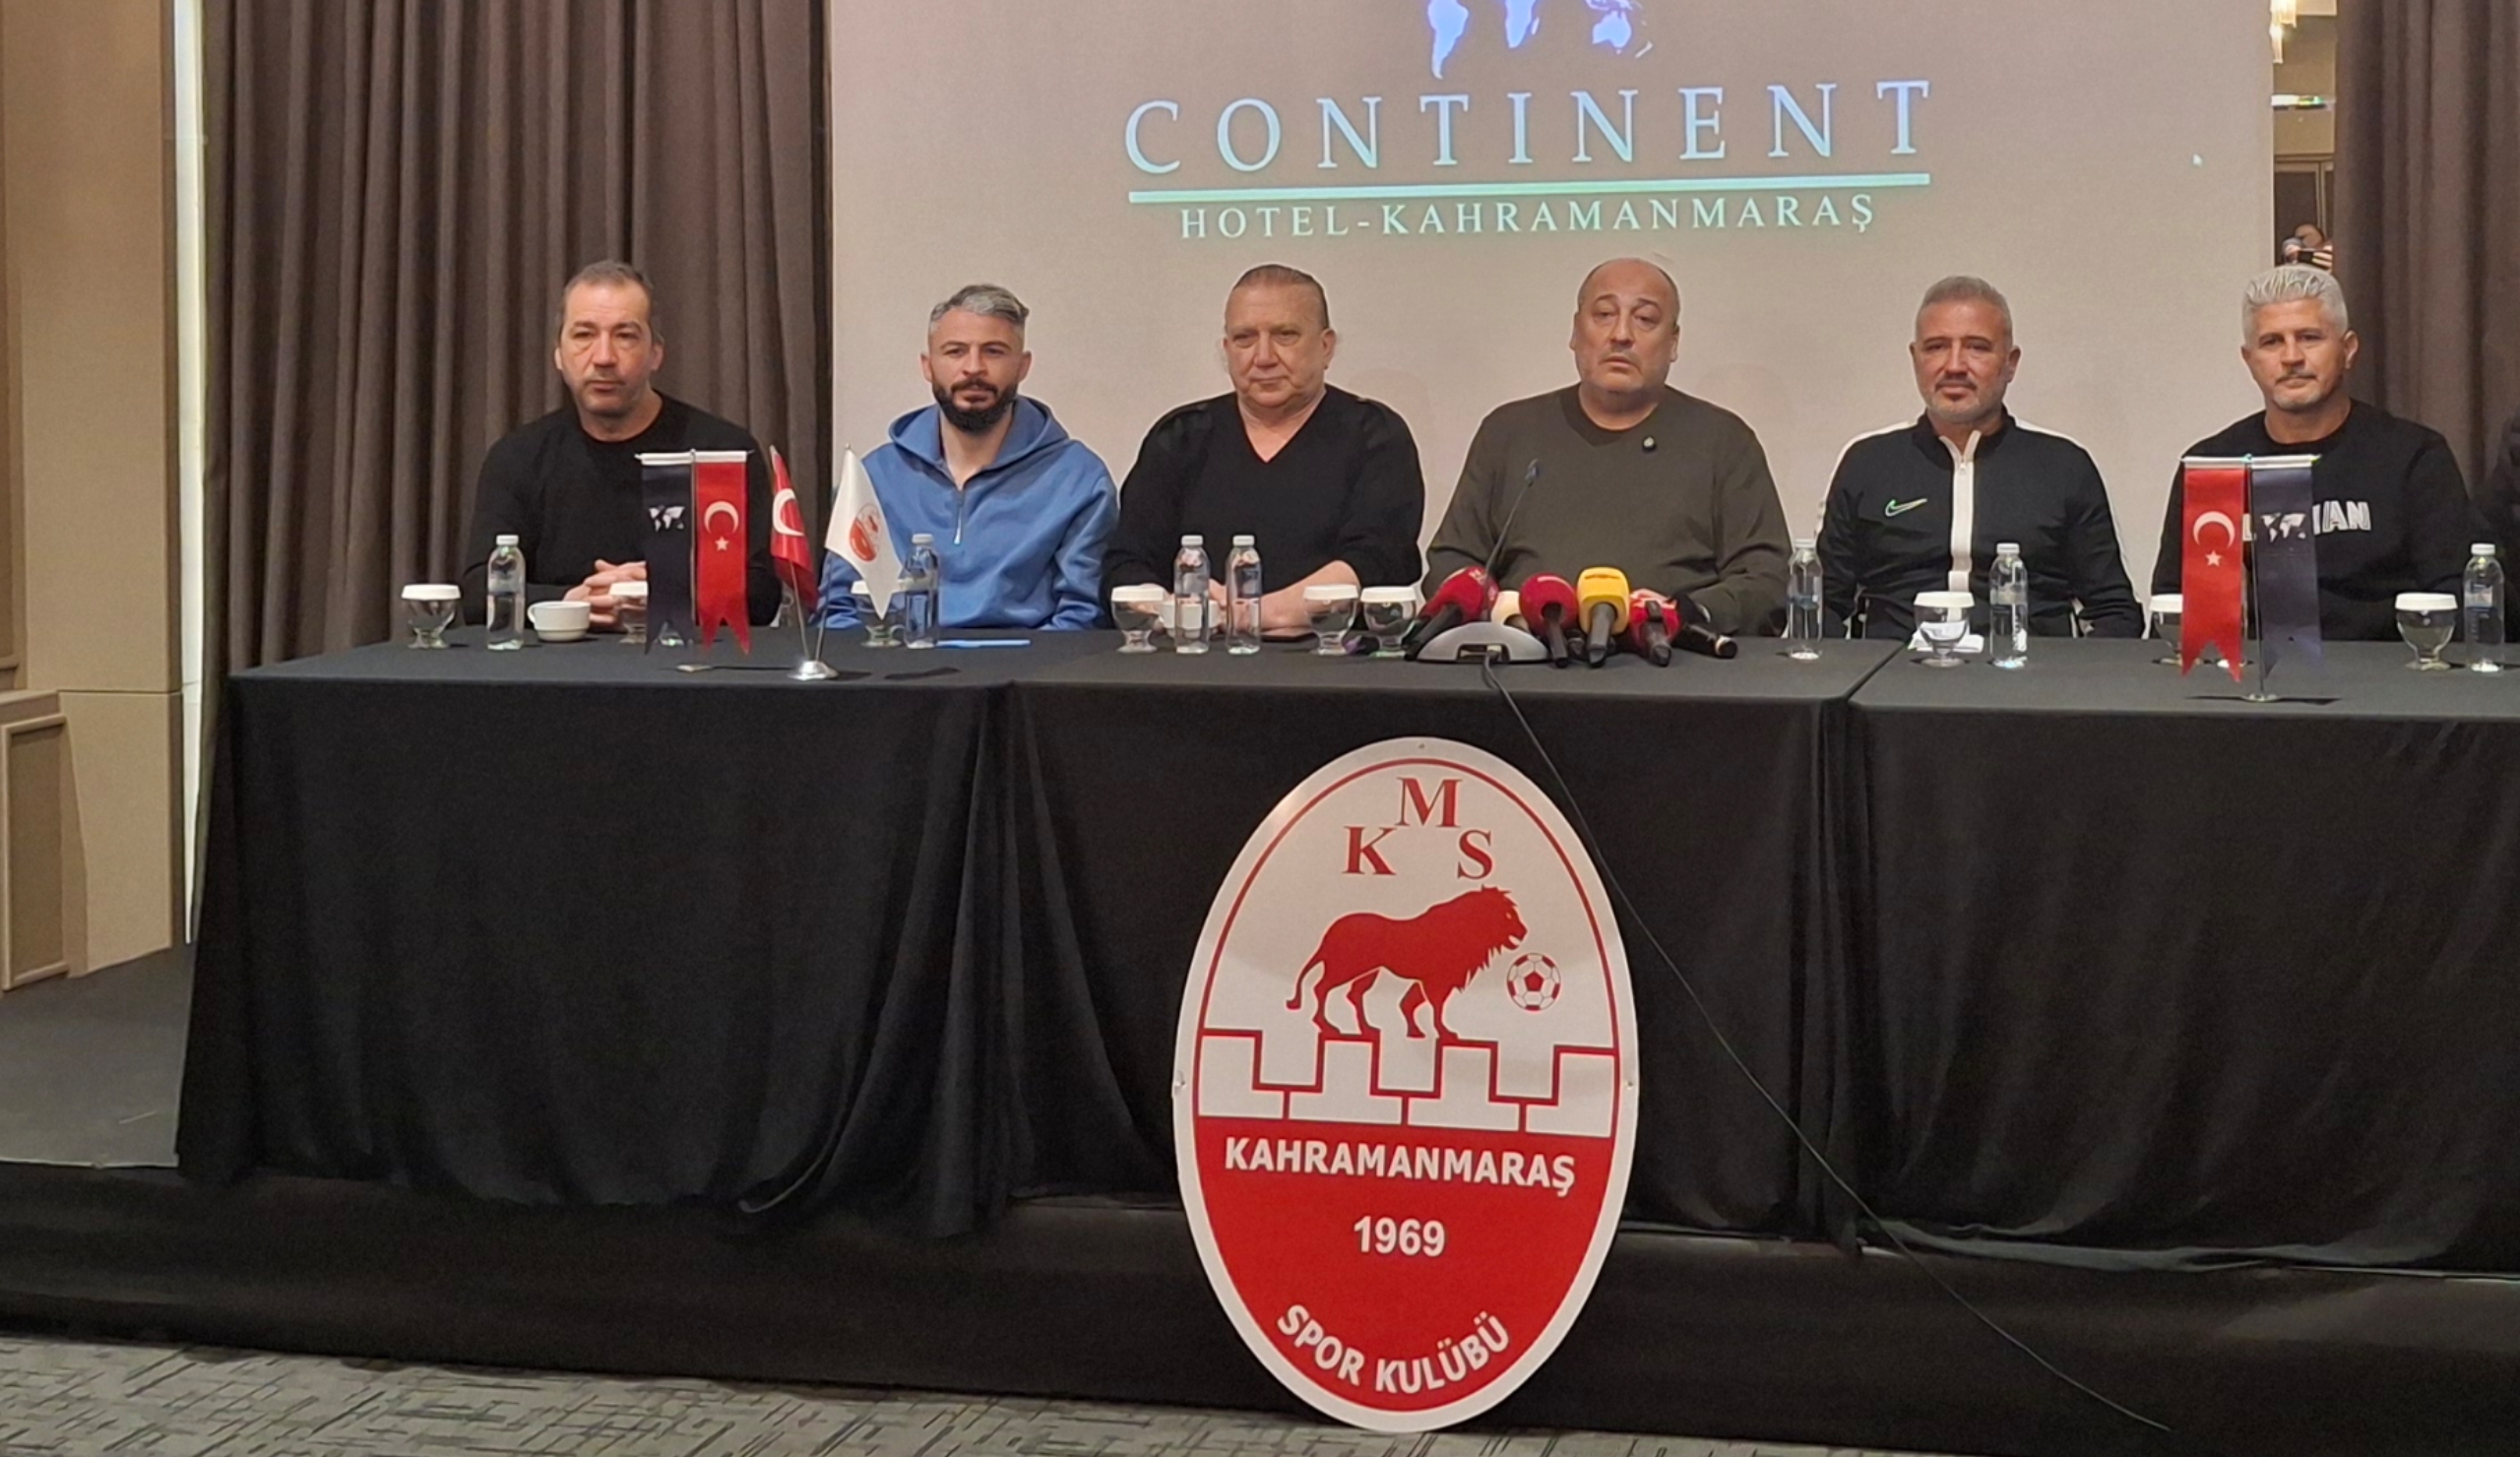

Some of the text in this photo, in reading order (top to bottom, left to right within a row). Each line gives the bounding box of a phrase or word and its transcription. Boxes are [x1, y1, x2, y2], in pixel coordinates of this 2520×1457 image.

[1124, 80, 1930, 174] CONTINENT
[1181, 193, 1875, 239] HOTEL-KAHRAMANMARAŞ
[1224, 1137, 1577, 1197] KAHRAMANMARAŞ
[1353, 1215, 1447, 1257] 1969
[1277, 1304, 1510, 1394] SPOR KULÜBÜ
